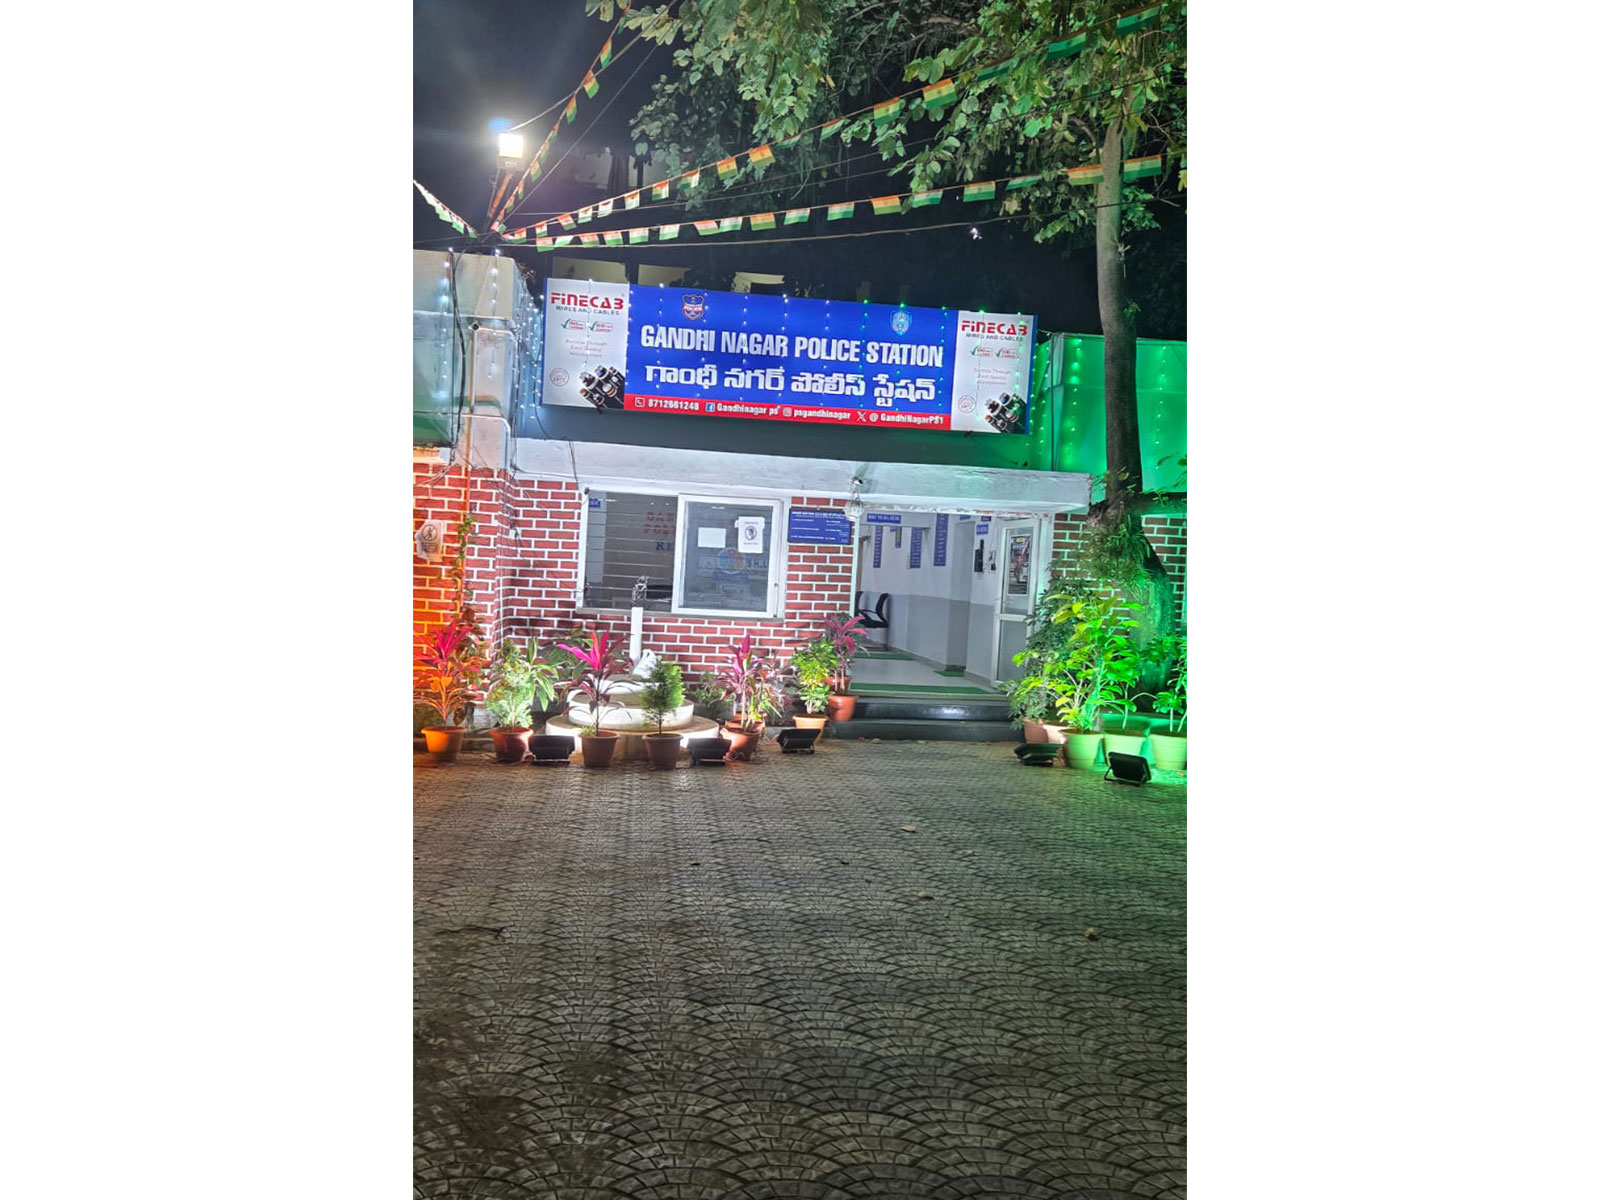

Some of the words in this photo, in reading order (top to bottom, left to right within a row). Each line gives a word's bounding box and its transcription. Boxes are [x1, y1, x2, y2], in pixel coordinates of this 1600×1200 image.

[555, 305, 577, 313] WIRES
[641, 325, 715, 352] GANDHI
[720, 331, 788, 357] NAGAR
[794, 336, 860, 362] POLICE
[866, 341, 944, 368] STATION
[645, 364, 718, 390] గాంధీ
[723, 366, 785, 391] నగర్
[790, 371, 866, 396] పోలీస్
[872, 374, 936, 407] స్టేషన్
[717, 402, 767, 416] Gandhinagar
